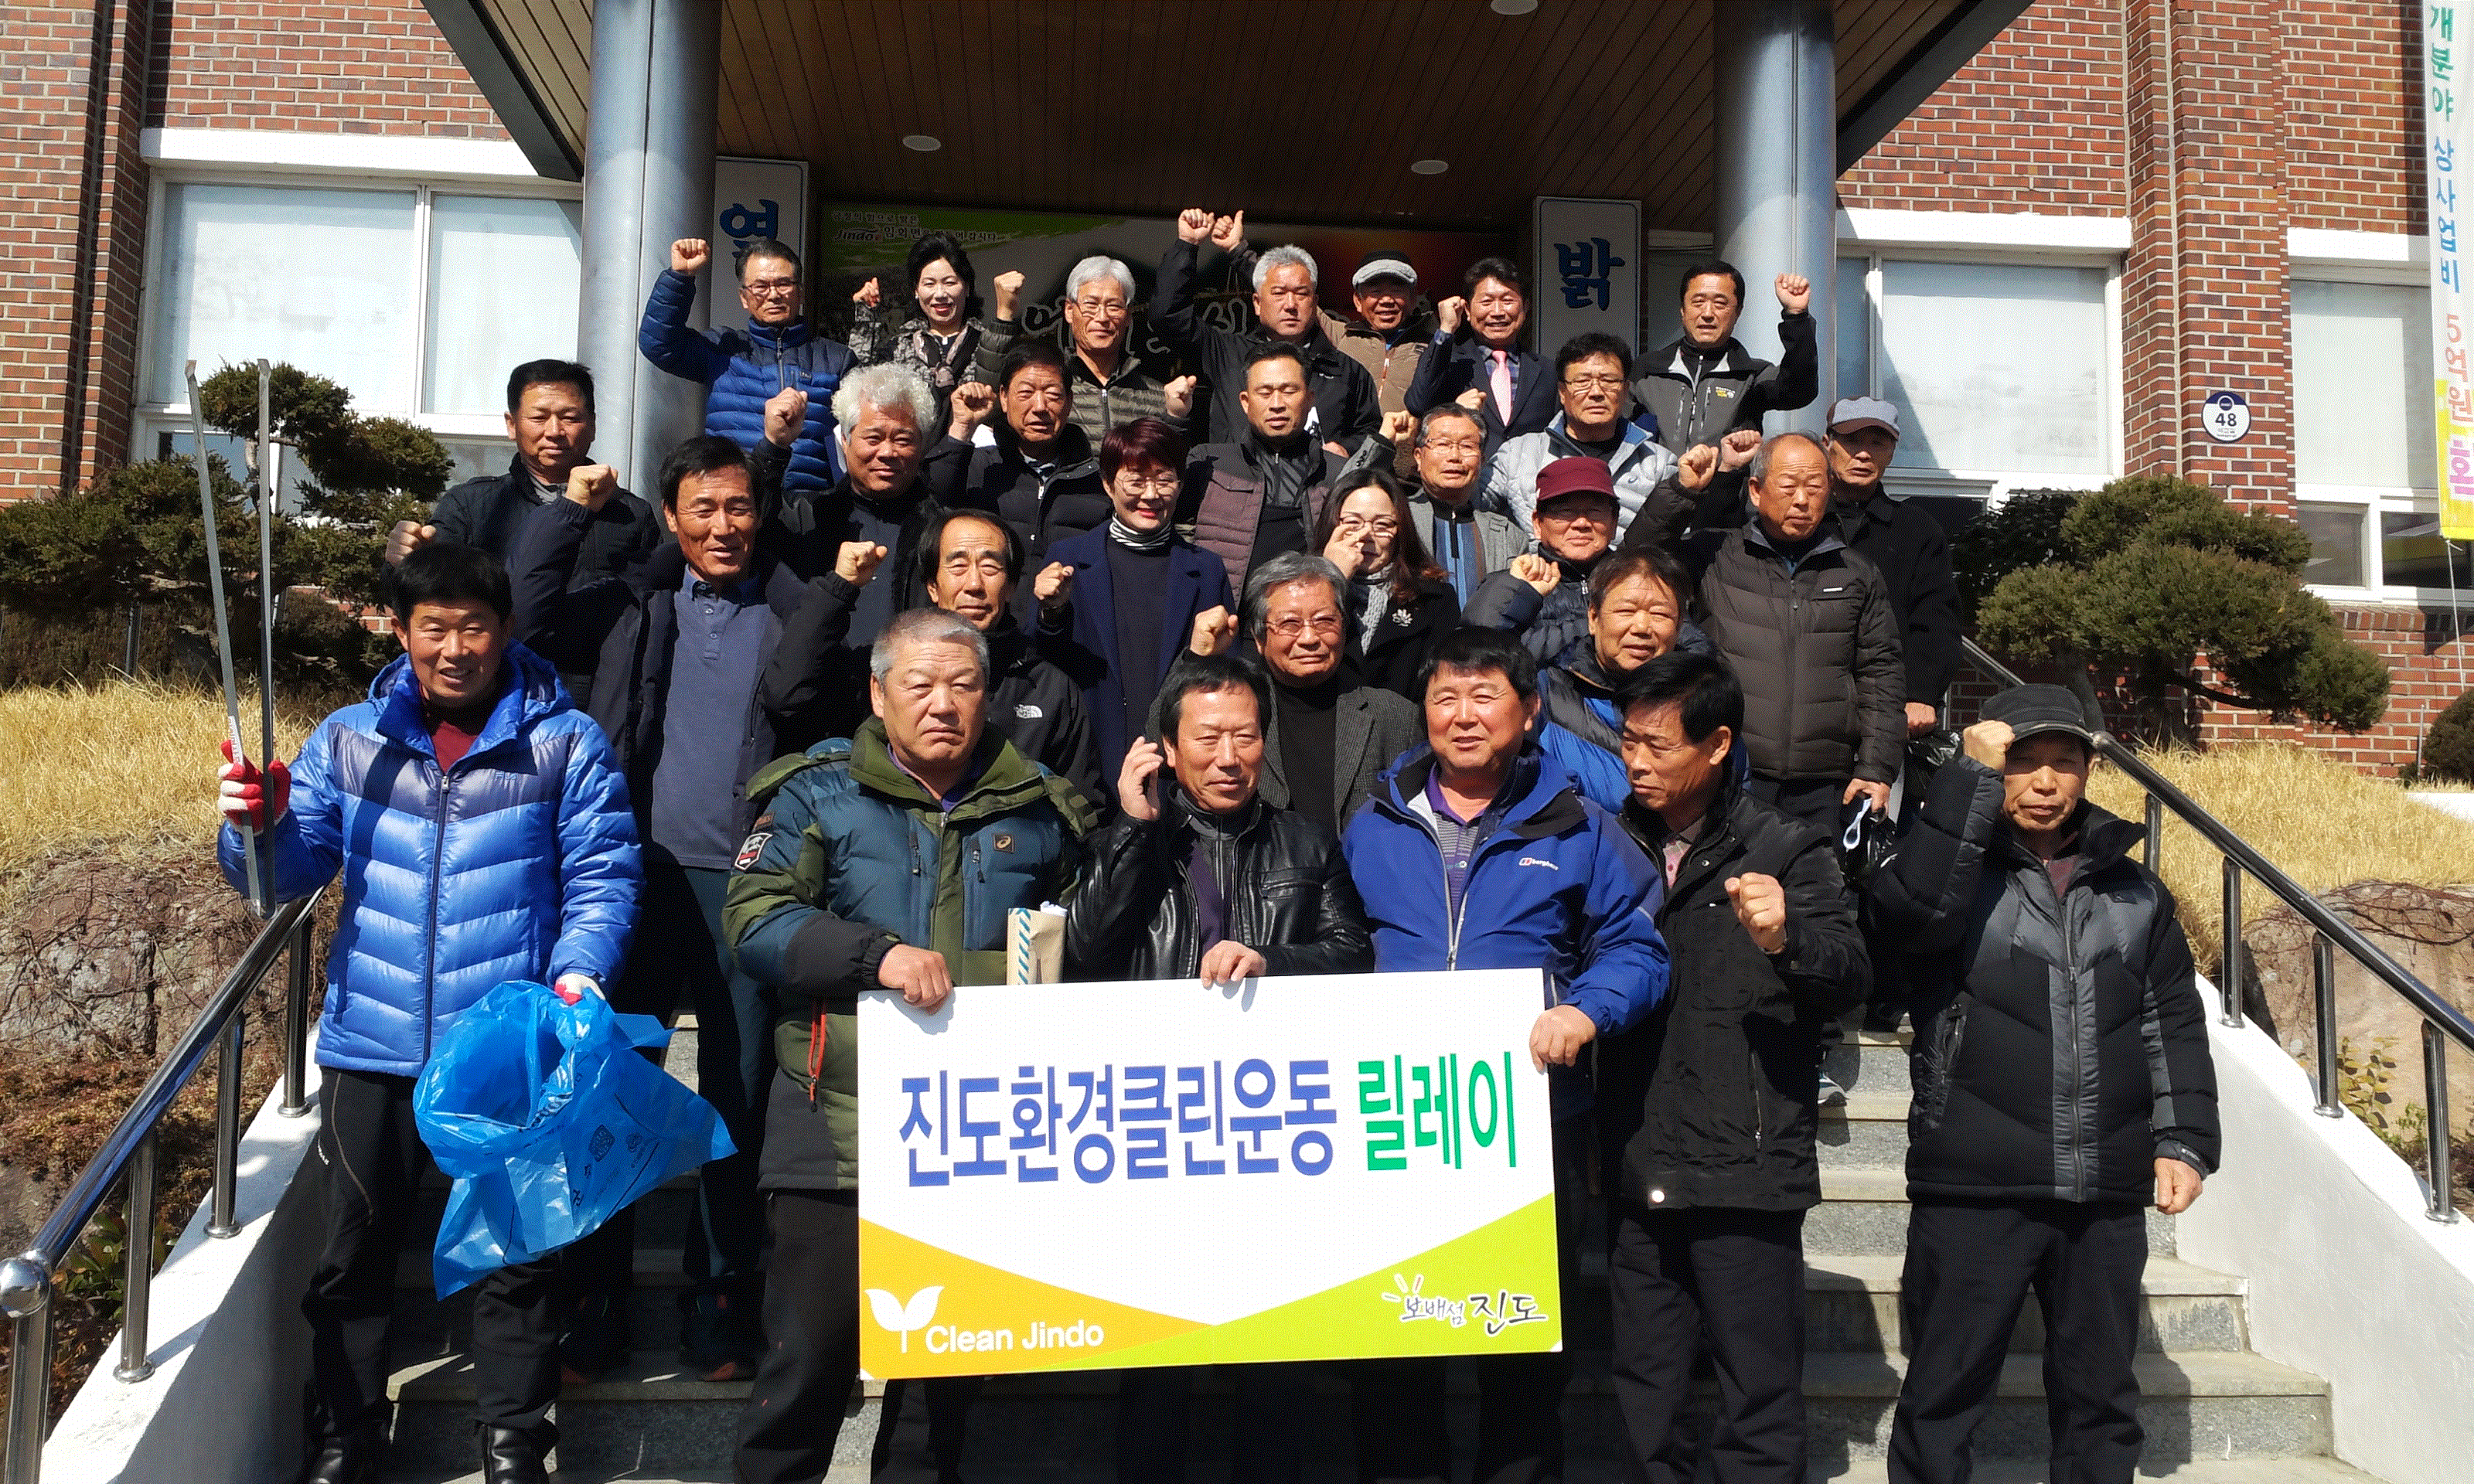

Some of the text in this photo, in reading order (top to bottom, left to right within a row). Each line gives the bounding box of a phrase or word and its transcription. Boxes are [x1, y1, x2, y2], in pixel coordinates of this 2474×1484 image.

[2430, 5, 2454, 122] 개분야
[2434, 136, 2459, 293] 상사업비
[1554, 237, 1625, 311] 밝
[2445, 313, 2474, 423] 5억원
[2215, 413, 2237, 427] 48
[899, 1052, 1517, 1187] 진도환경클린운동 릴레이
[925, 1319, 1105, 1354] Clean Jindo
[1402, 1292, 1547, 1335] 보배섬 진도
